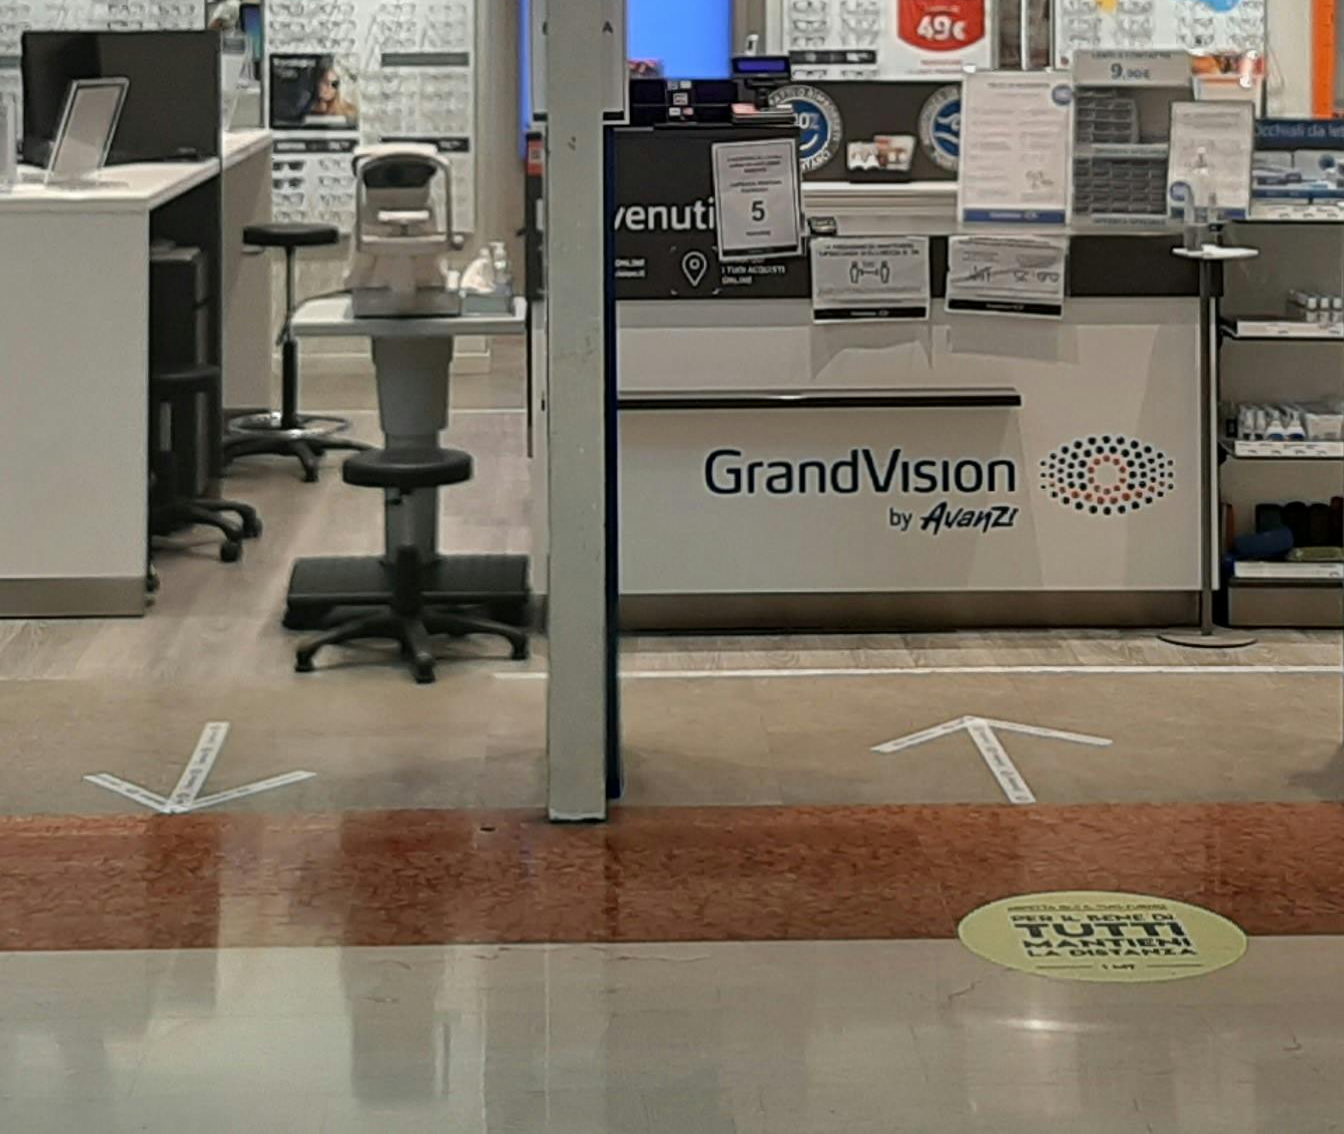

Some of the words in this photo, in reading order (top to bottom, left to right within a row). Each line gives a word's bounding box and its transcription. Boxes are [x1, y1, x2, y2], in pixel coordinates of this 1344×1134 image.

[1308, 123, 1325, 137] da
[613, 196, 715, 230] venuti
[752, 200, 765, 221] 5
[704, 448, 1016, 494] GrandVision
[889, 507, 913, 532] by
[1011, 914, 1053, 922] PER
[1061, 914, 1081, 922] IL
[1087, 913, 1143, 922] BENE
[1152, 913, 1174, 921] DI
[1014, 922, 1185, 938] TUTTI
[1023, 938, 1193, 948] MANTIENI
[1027, 948, 1061, 957] LA
[1069, 948, 1198, 957] DISTANZA
